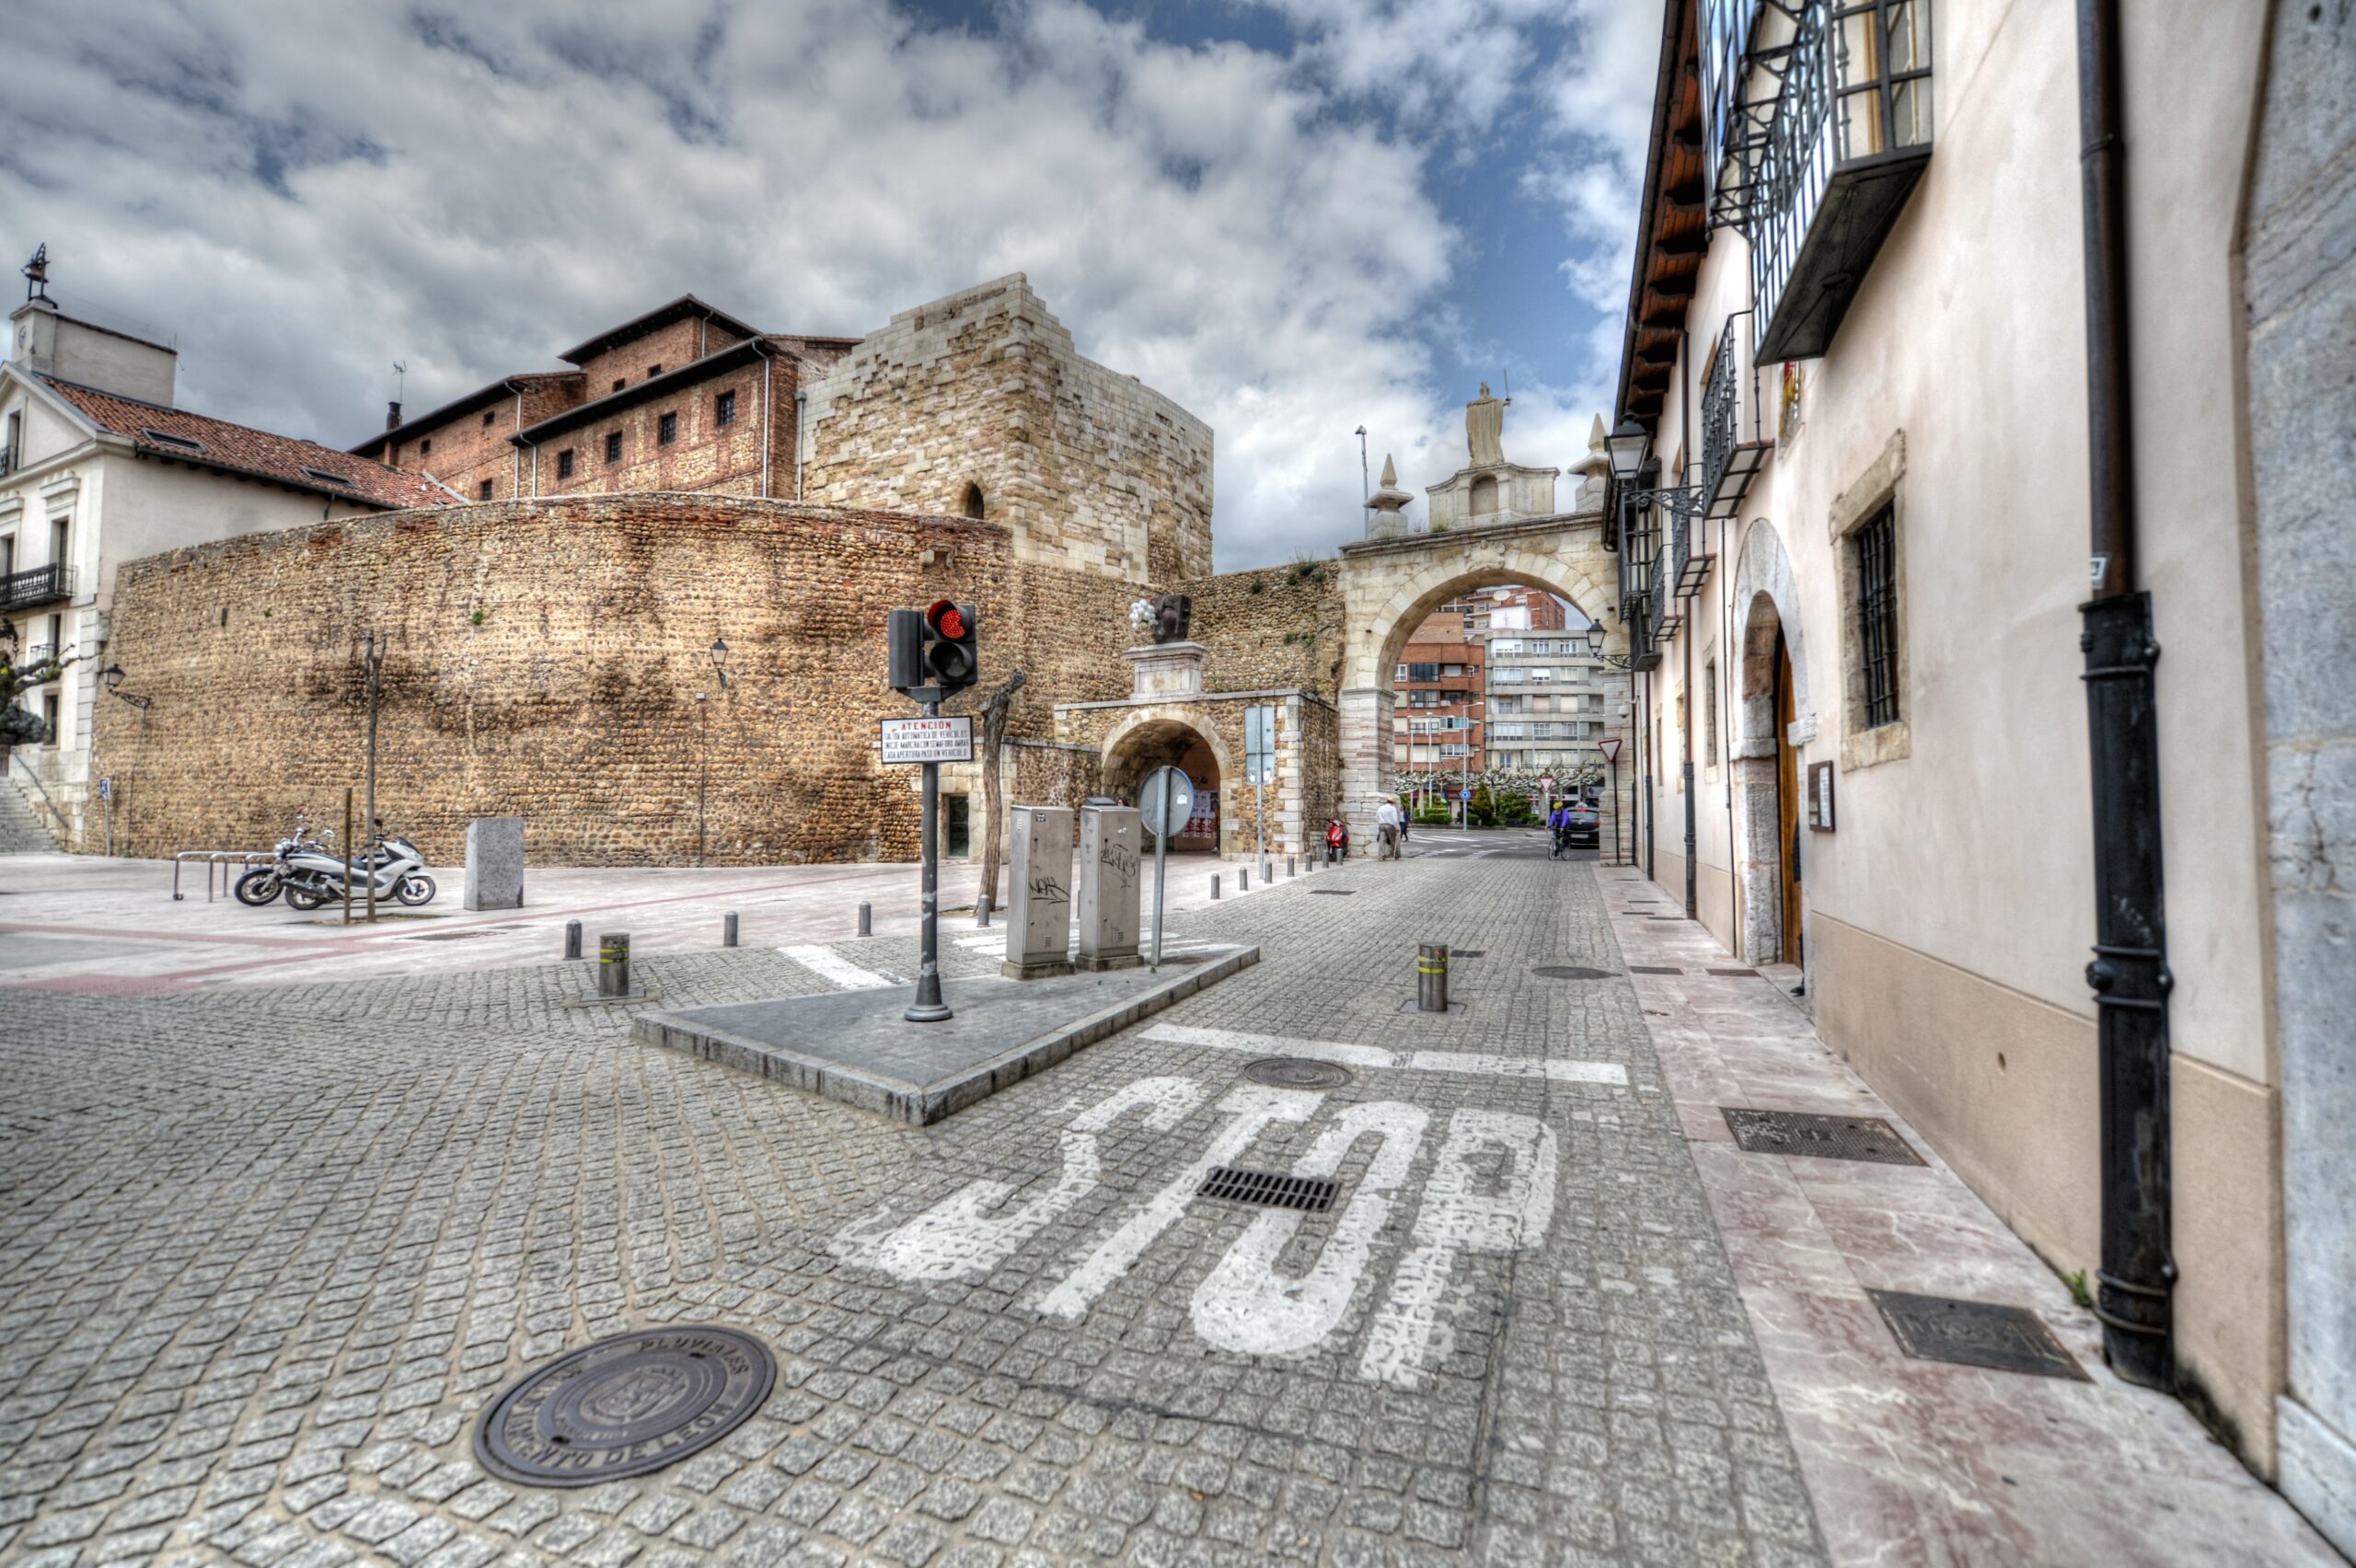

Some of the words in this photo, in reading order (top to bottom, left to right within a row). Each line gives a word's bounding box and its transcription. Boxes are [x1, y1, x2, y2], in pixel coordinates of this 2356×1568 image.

[901, 721, 952, 731] ATENCION
[940, 730, 967, 739] VEHICULOS
[900, 740, 919, 749] MARCHA
[920, 740, 930, 748] CON
[896, 750, 920, 759] APERTURA
[941, 748, 966, 757] VEHICULO
[827, 1075, 1558, 1389] STOP
[640, 1337, 750, 1376] PLUVIALES
[603, 1442, 647, 1465] DE
[659, 1402, 733, 1451] LEON
